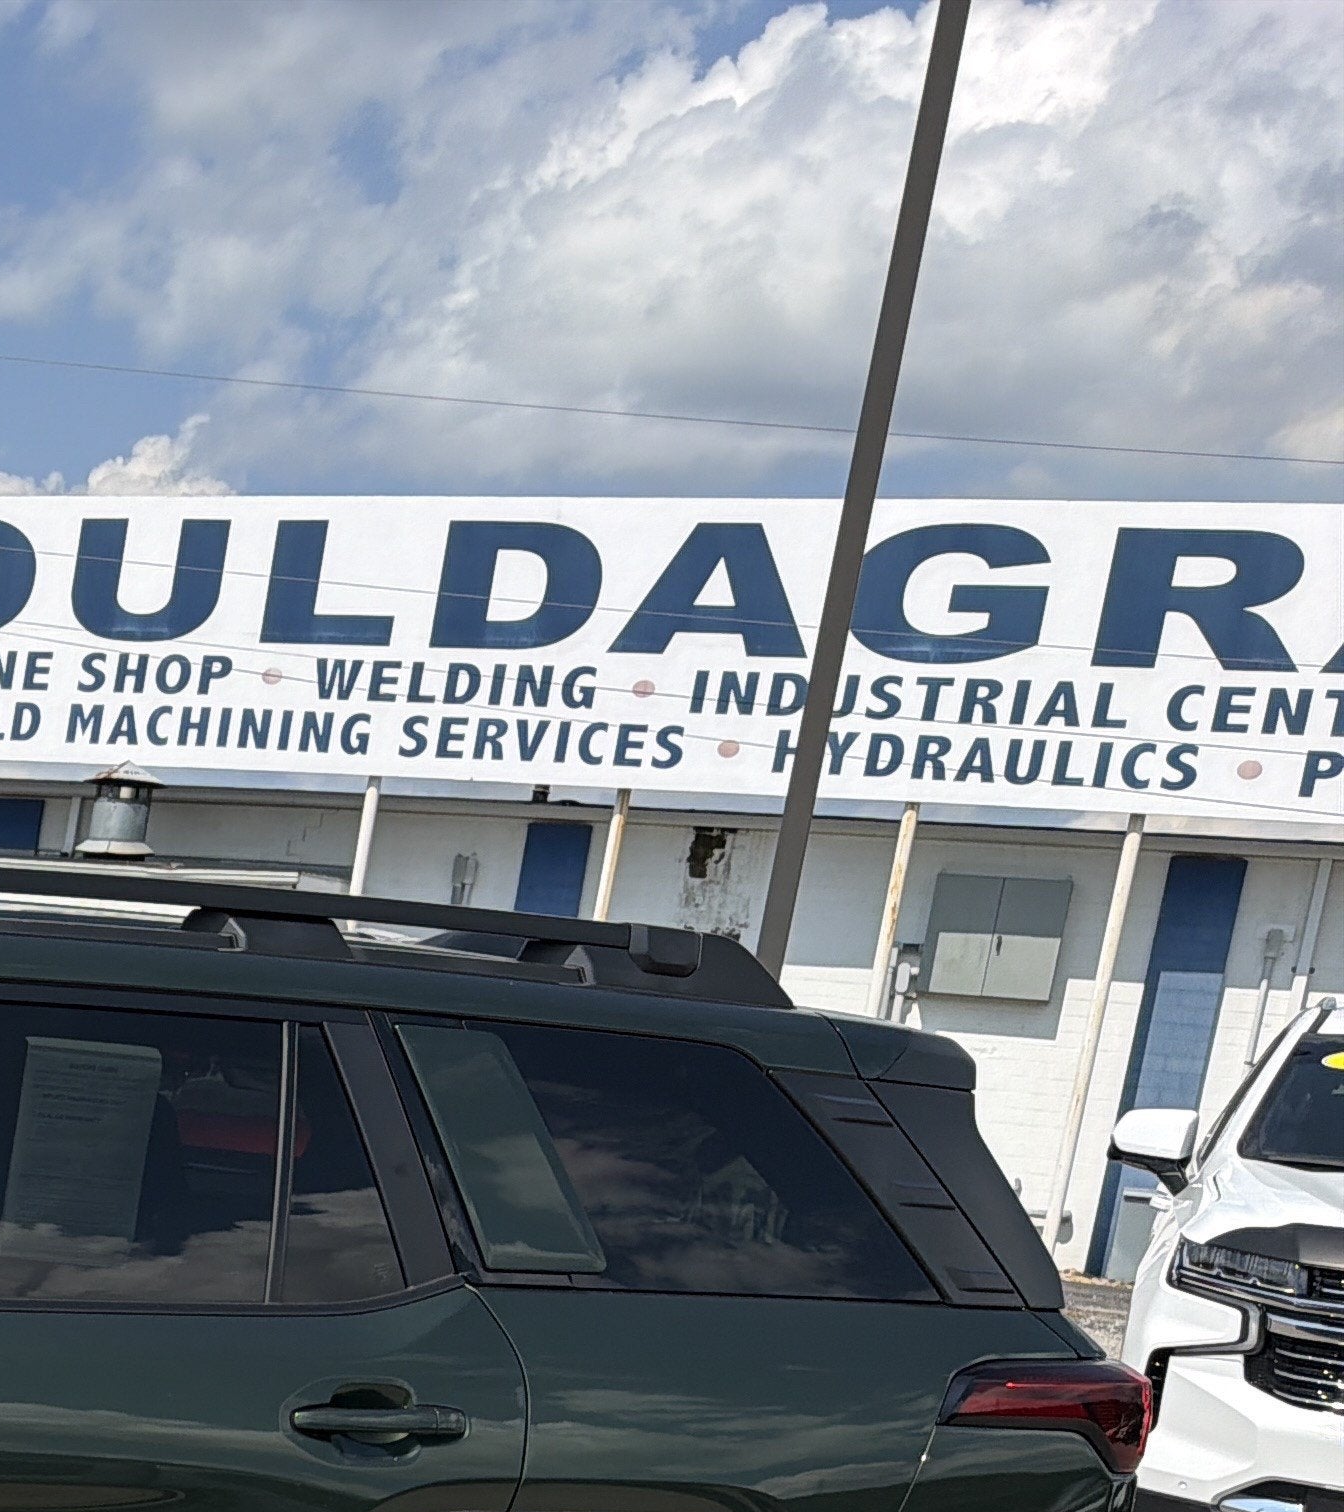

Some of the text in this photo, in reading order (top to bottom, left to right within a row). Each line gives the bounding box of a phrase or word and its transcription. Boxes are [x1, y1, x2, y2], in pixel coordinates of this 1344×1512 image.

[76, 651, 234, 696] SHOP
[315, 657, 599, 710] WELDING
[64, 703, 372, 756] MACHINING
[397, 714, 686, 770] SERVICES
[770, 728, 1200, 792] HYDRAULICS
